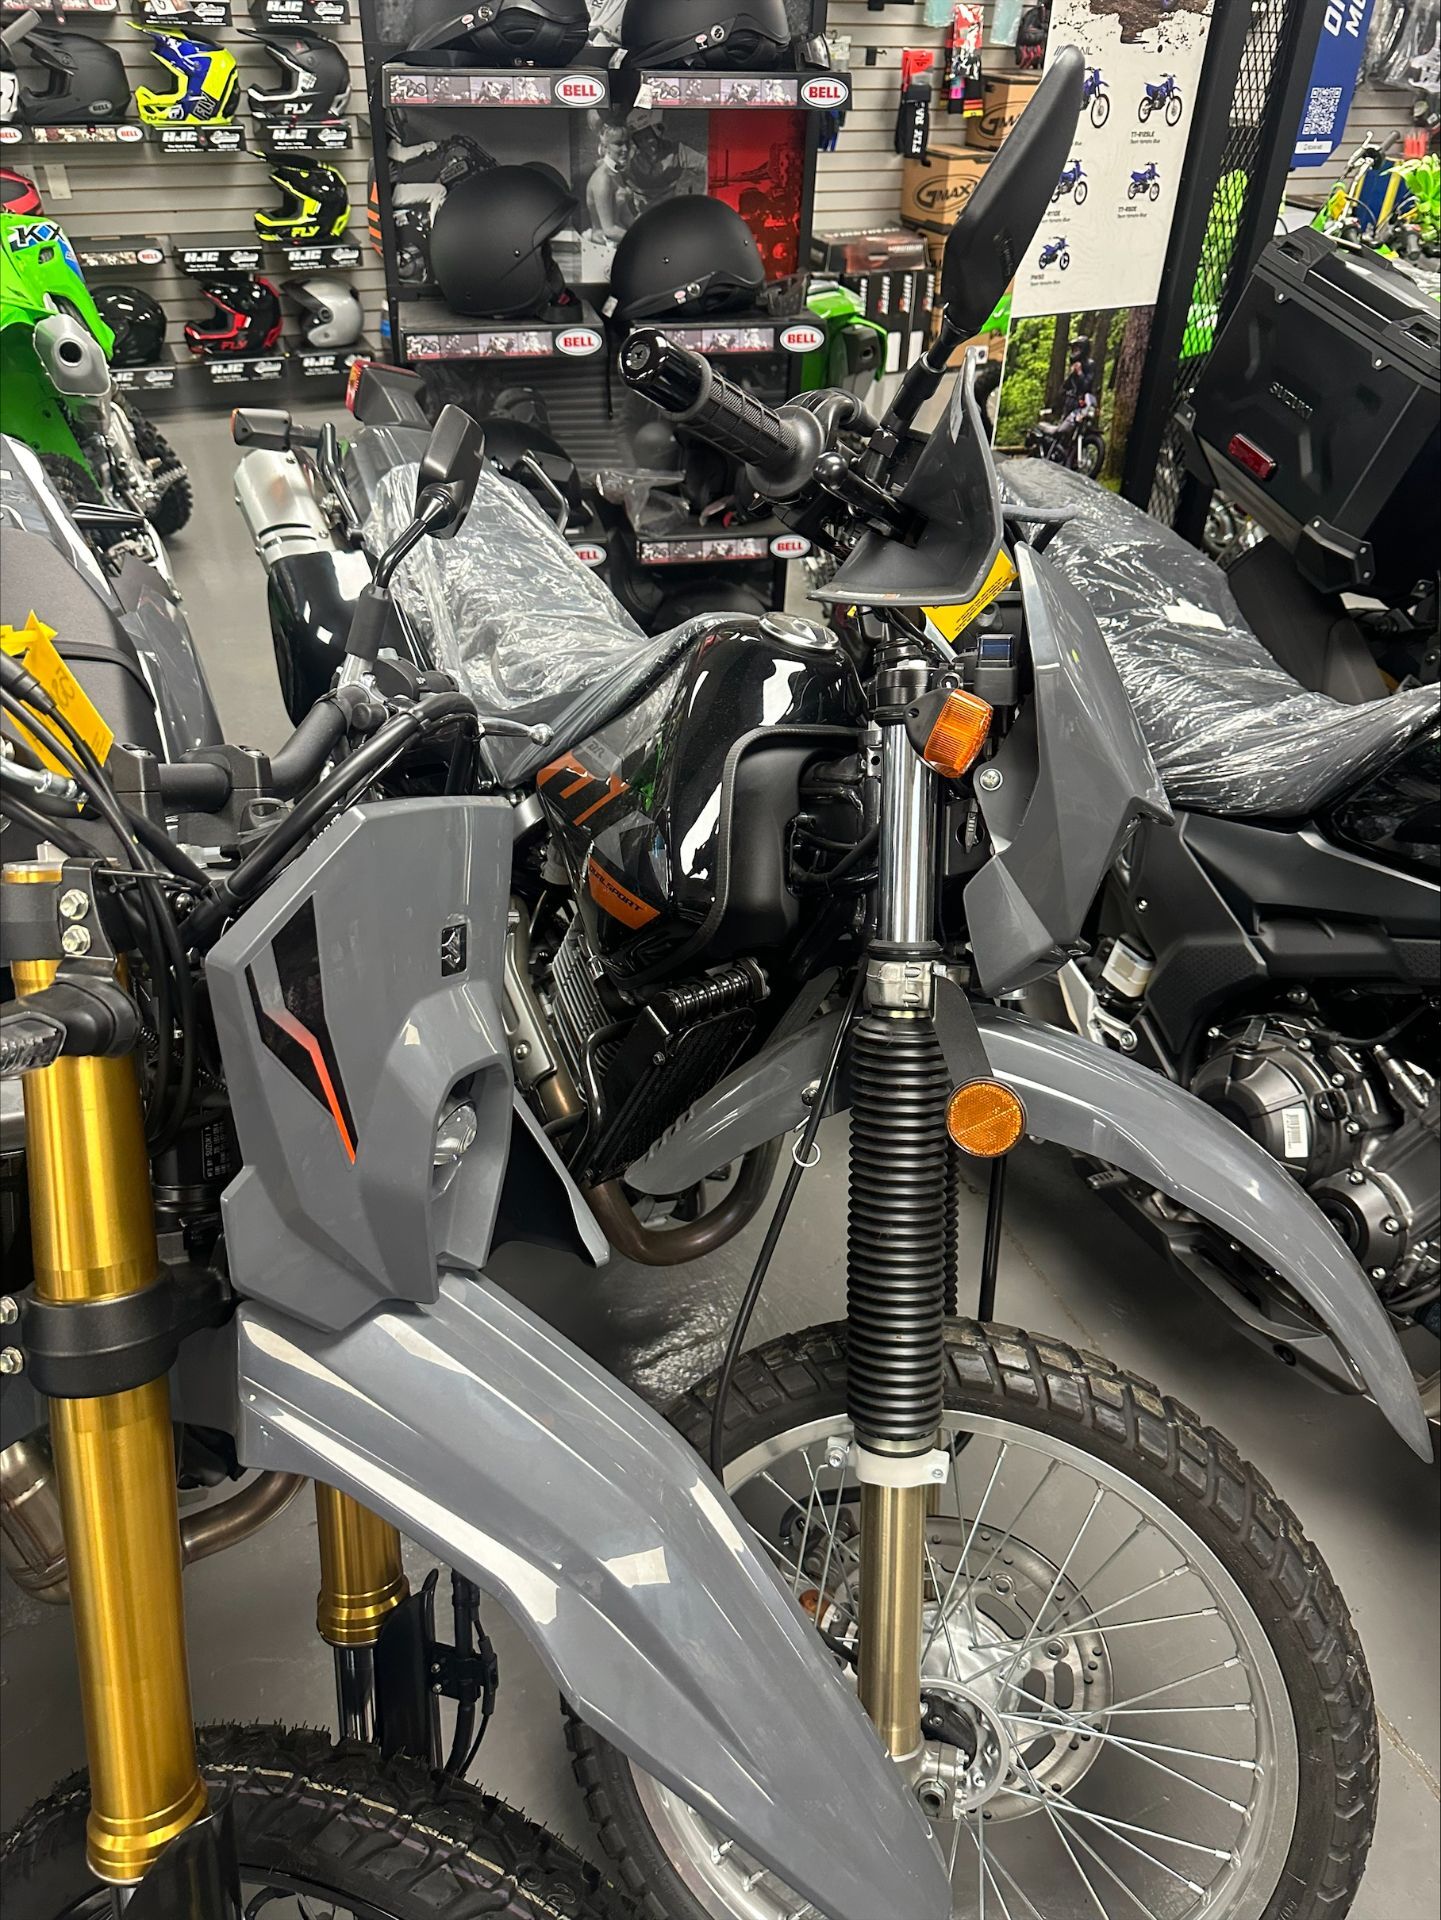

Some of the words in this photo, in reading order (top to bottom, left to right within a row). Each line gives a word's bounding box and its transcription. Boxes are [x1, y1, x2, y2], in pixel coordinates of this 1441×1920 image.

[563, 84, 597, 97] BELL
[808, 86, 841, 99] BELL
[192, 91, 217, 120] FLY
[284, 103, 313, 114] FLY
[162, 131, 198, 142] HJC
[272, 129, 308, 140] HJC
[912, 129, 923, 153] FLY
[916, 184, 972, 208] GMAX
[14, 225, 65, 244] KX
[291, 226, 320, 237] FLY
[184, 252, 220, 262] HJC
[288, 250, 322, 261] HJC
[563, 336, 595, 348] BELL
[787, 333, 816, 345] BELL
[220, 340, 248, 350] FLY
[112, 372, 135, 381] JC
[1269, 382, 1313, 420] SUZUKI
[777, 541, 803, 552] BELL
